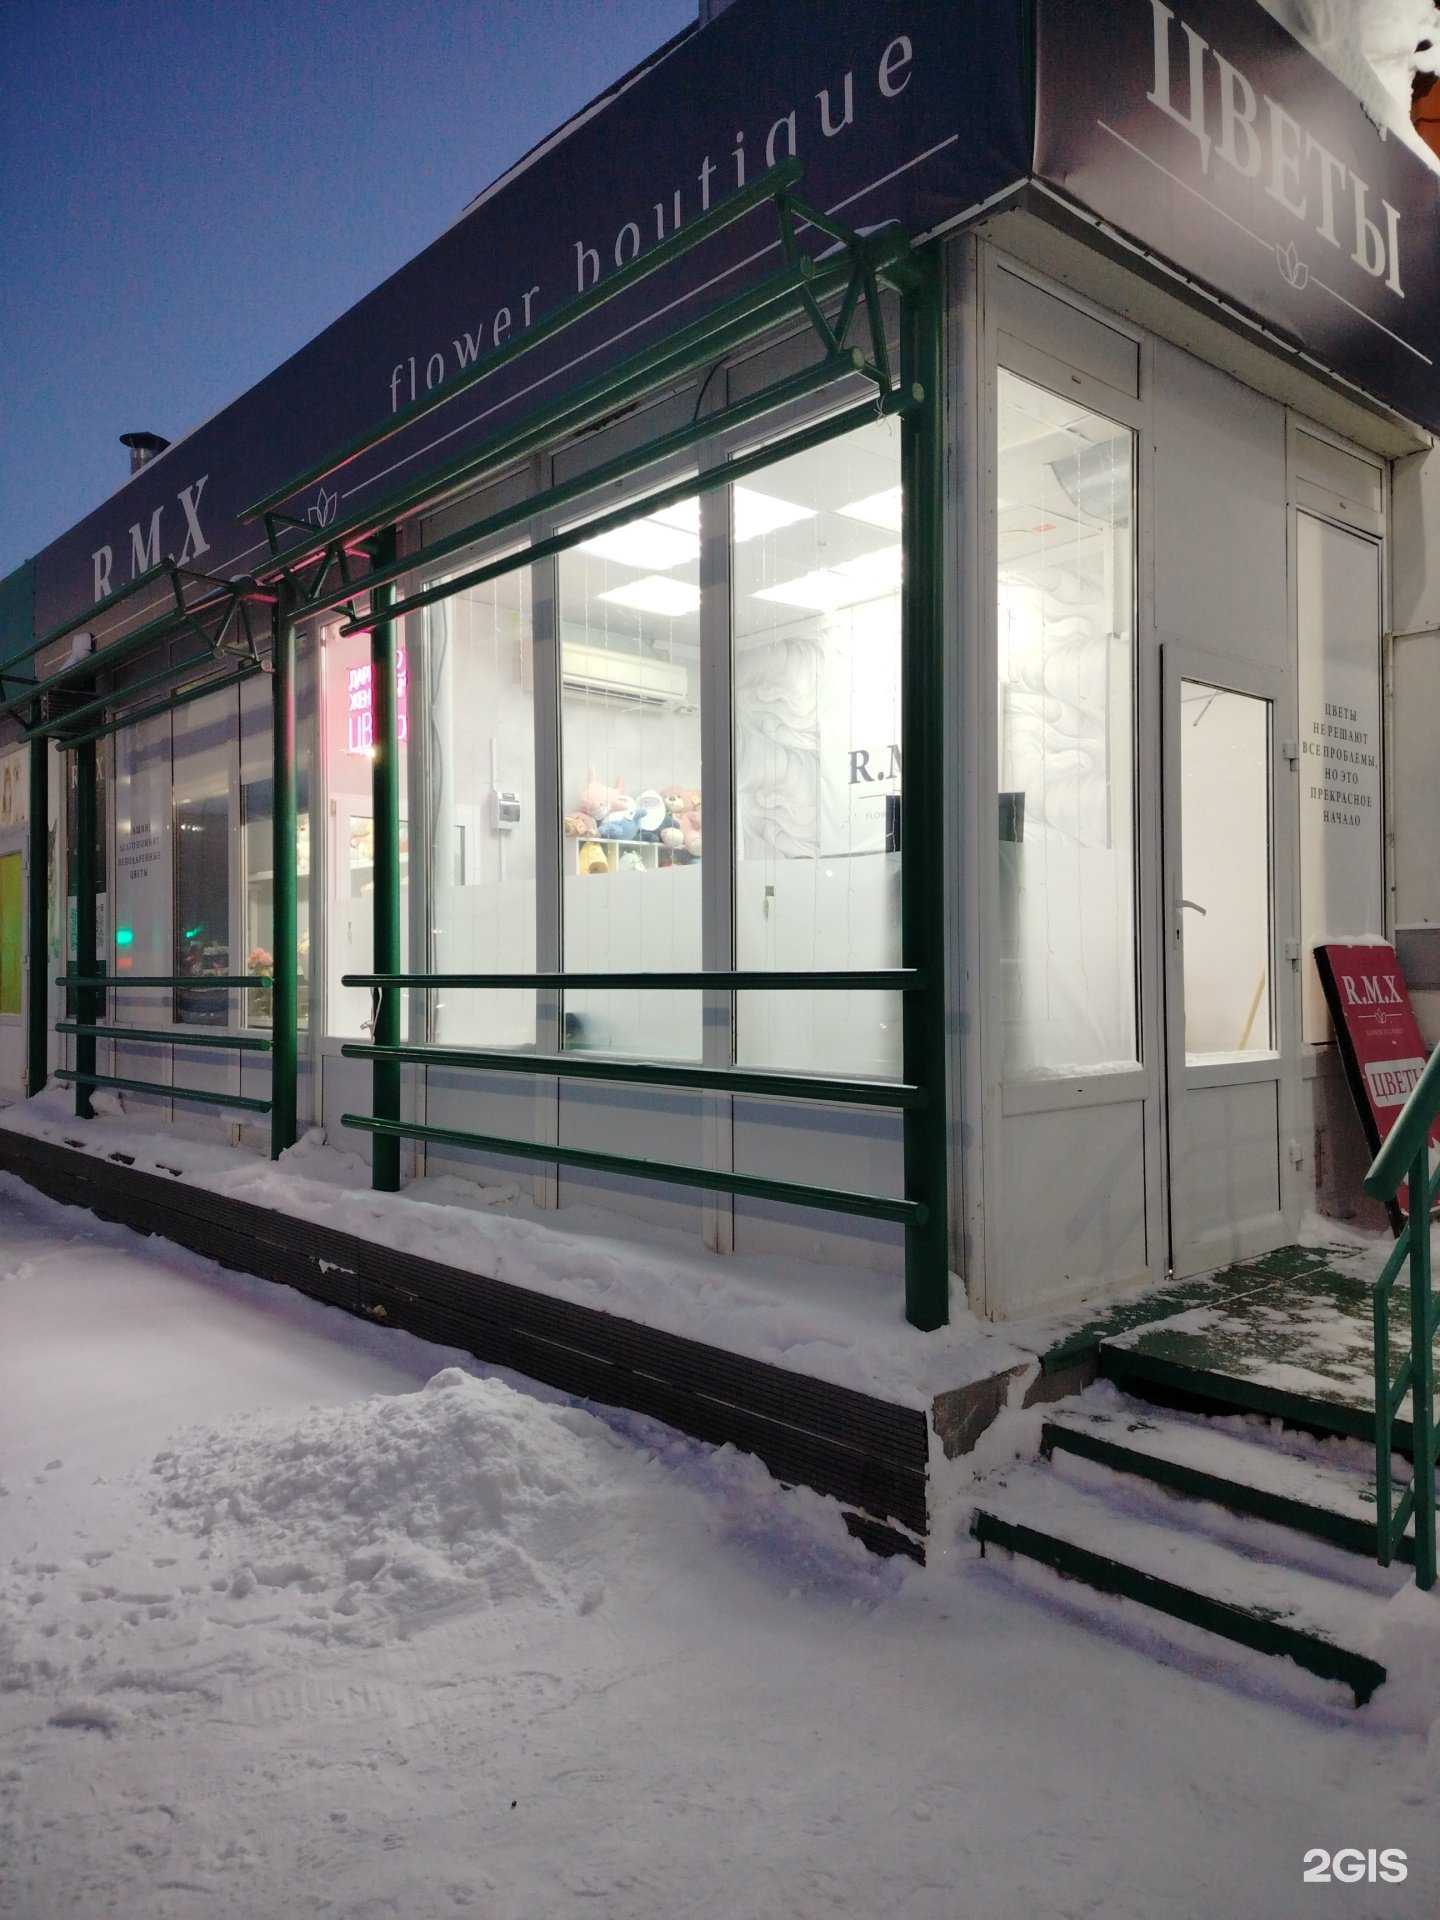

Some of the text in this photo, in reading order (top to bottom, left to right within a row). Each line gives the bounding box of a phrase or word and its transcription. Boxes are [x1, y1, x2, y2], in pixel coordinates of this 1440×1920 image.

[1146, 0, 1405, 299] ЦВЕТЫ
[389, 286, 540, 413] flower
[1325, 703, 1357, 722] ЦВЕТЫ
[1313, 722, 1368, 745] НЕ РЕШАЮТ
[1302, 741, 1320, 757] ВСЕ
[1325, 767, 1358, 784] НО ЭТО
[1311, 786, 1372, 808] ПРЕКРАСНОЕ
[1323, 810, 1360, 826] НАЧАЛО
[1341, 975, 1403, 1005] R.M.X
